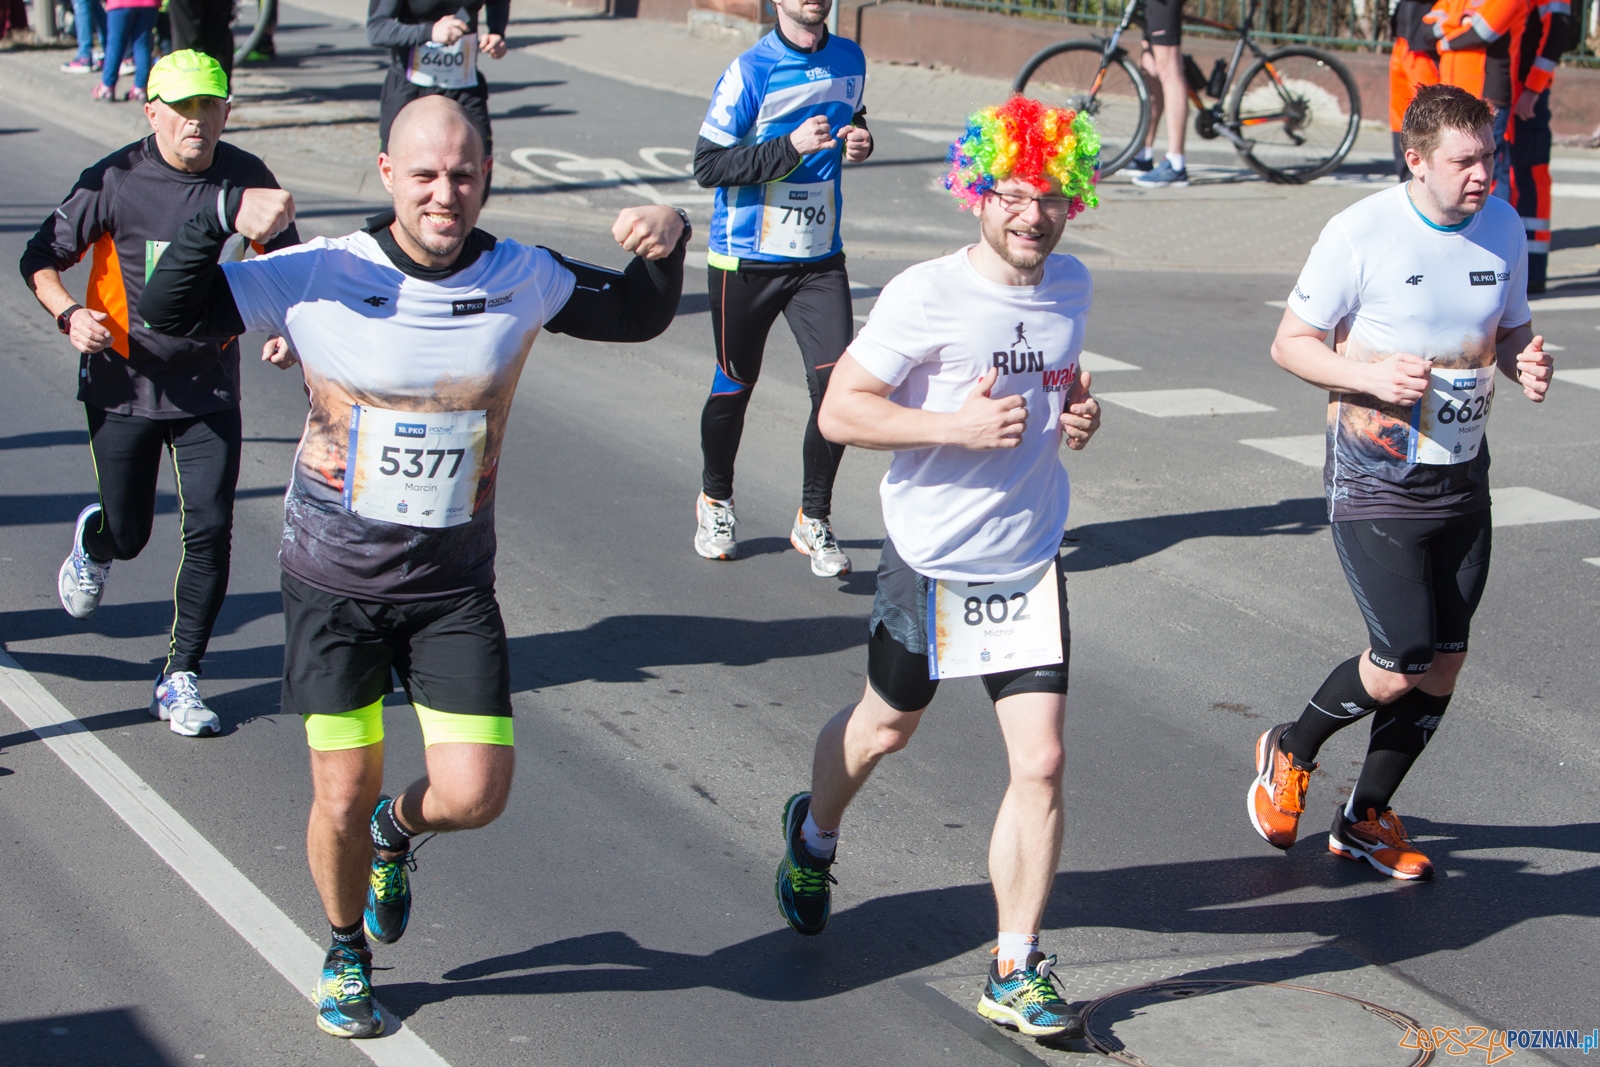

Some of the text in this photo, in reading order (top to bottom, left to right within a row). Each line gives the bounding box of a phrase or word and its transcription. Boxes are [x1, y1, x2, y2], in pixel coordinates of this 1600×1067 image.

[421, 52, 464, 67] 6400
[780, 205, 826, 226] 7196
[1405, 275, 1424, 286] 4F
[1481, 274, 1495, 282] PKO
[363, 295, 389, 307] 4F
[455, 302, 484, 312] 10. PKO
[992, 350, 1044, 376] RUN
[1042, 385, 1061, 393] TEAM
[1437, 391, 1492, 425] 6628
[397, 426, 408, 434] 10.
[408, 427, 424, 435] PKO
[1458, 424, 1480, 434] Maksim
[379, 445, 466, 479] 5377
[404, 482, 438, 492] Marcin
[963, 591, 1031, 626] 802
[1443, 641, 1465, 651] cep
[1375, 656, 1395, 669] cep
